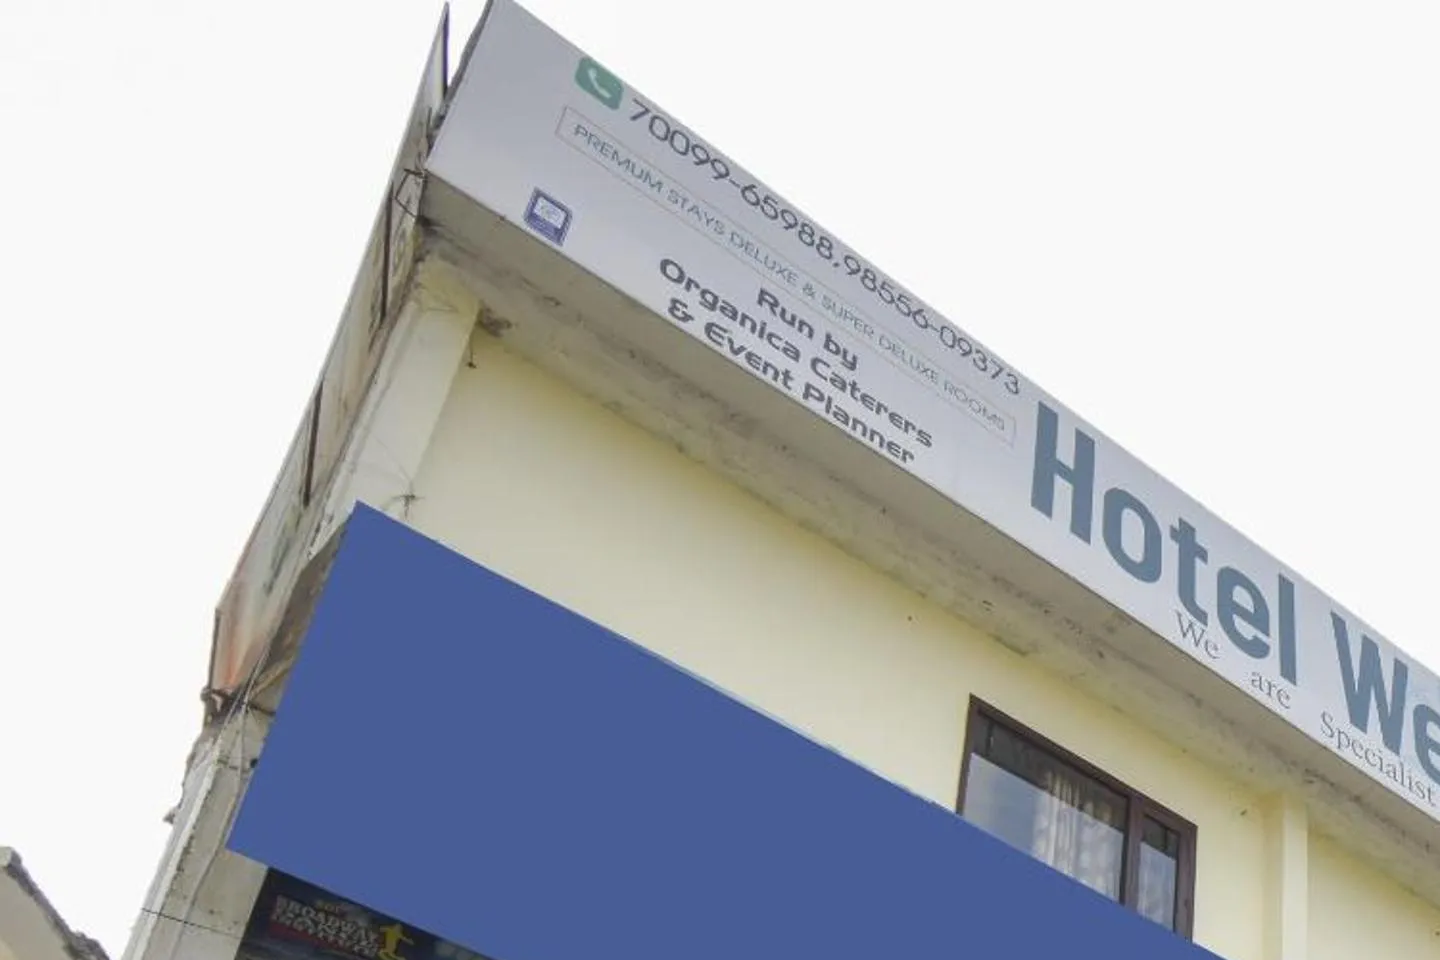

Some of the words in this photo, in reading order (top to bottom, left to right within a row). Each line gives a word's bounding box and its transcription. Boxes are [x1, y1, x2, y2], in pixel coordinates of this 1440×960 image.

[666, 189, 725, 236] STAYS
[730, 232, 799, 286] DELUXE
[821, 293, 875, 338] SUPER
[757, 287, 815, 341] Run
[823, 332, 859, 372] by
[660, 258, 800, 364] Organica
[811, 357, 933, 449] Caterers
[668, 297, 694, 323] &
[704, 322, 796, 391] Event
[802, 382, 915, 464] Planner
[1030, 400, 1297, 686] Hotel
[1174, 609, 1222, 660] We
[1250, 669, 1293, 709] are
[1320, 709, 1435, 808] Specialist
